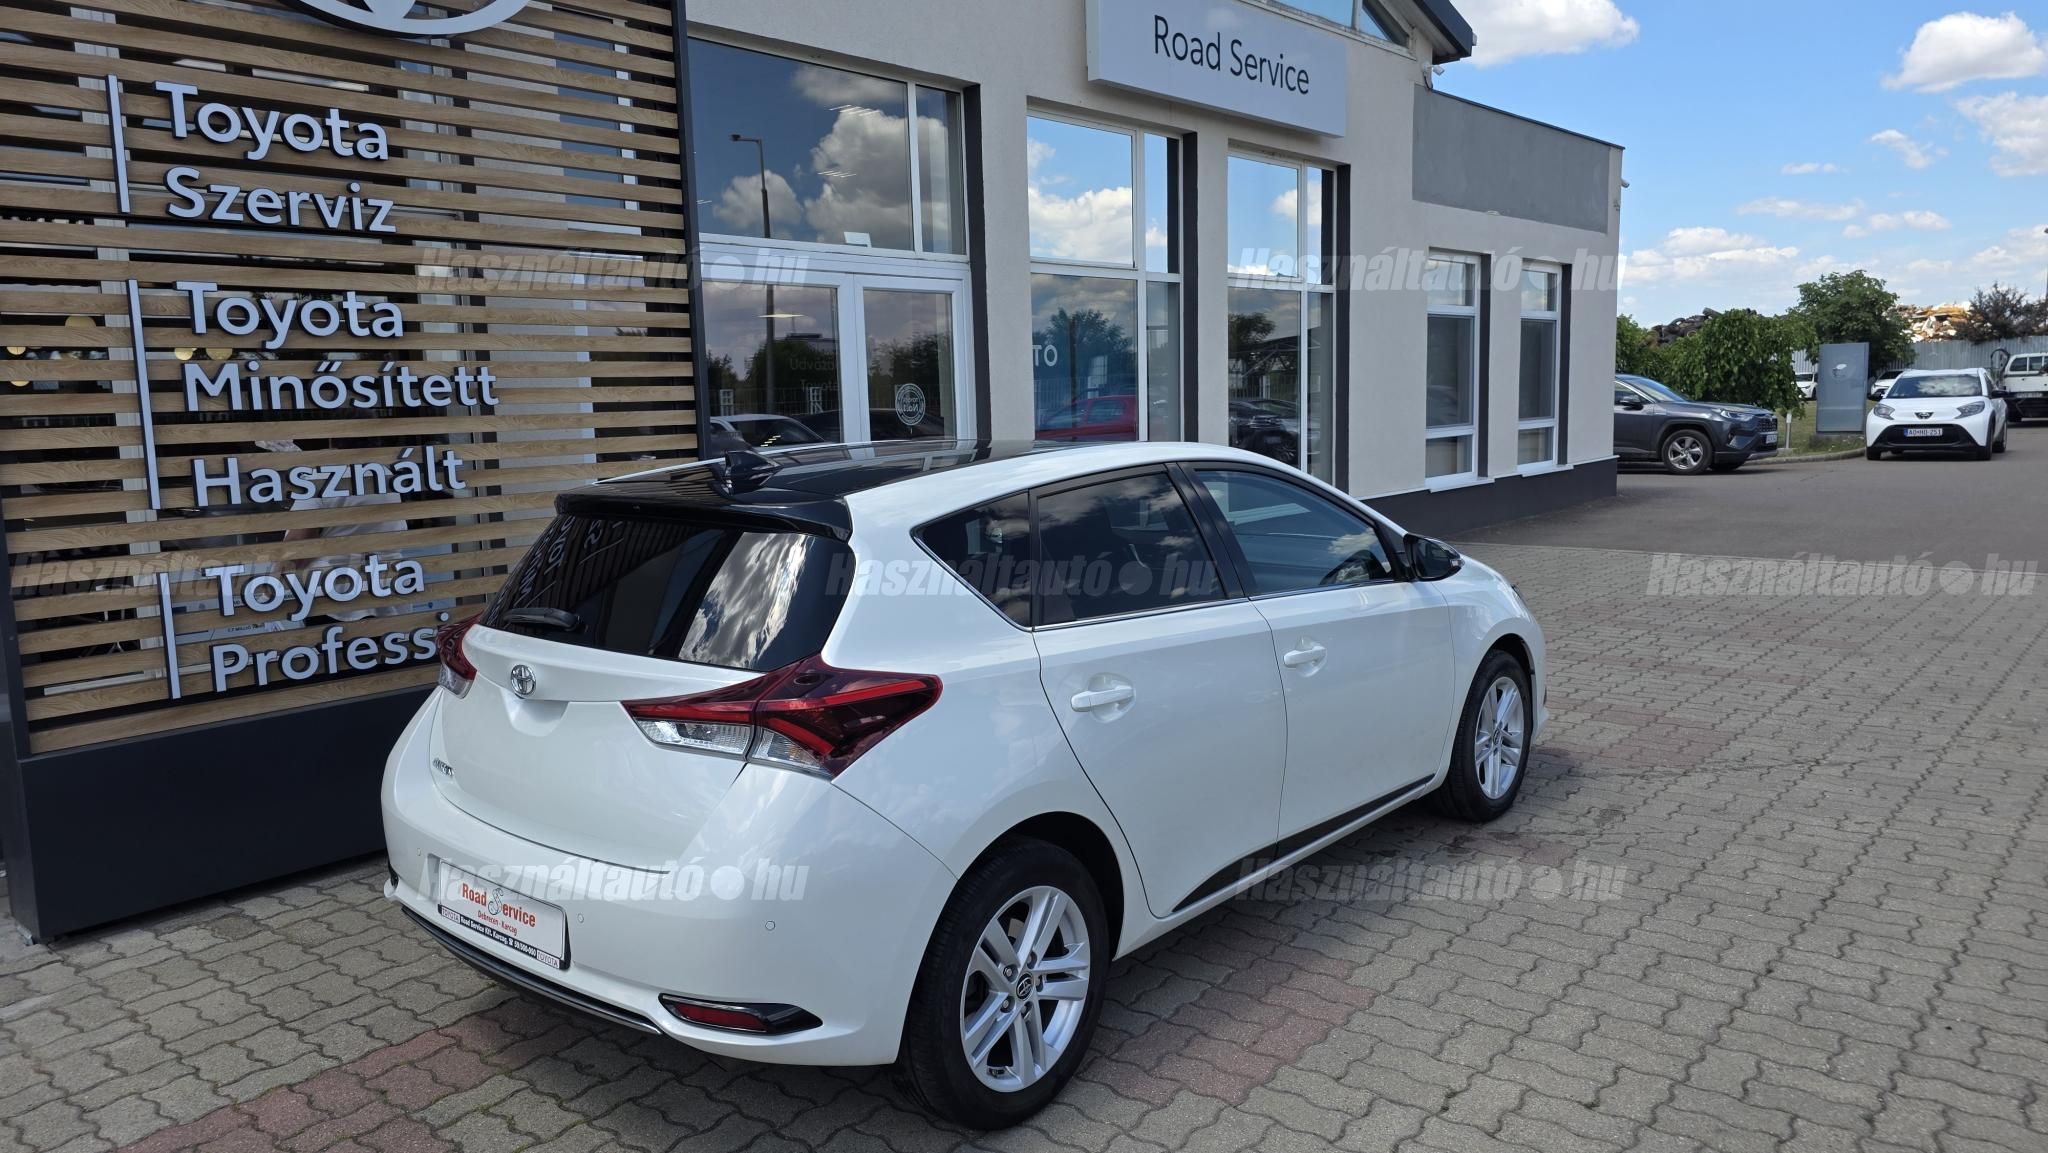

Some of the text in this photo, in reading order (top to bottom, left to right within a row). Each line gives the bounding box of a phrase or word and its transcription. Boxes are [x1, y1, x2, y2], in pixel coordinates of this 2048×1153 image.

[1154, 14, 1310, 95] Road Service
[154, 80, 389, 161] Toyota
[164, 166, 397, 233] Szerviz
[173, 280, 404, 350] Toyota
[182, 360, 499, 412] Minősített
[192, 445, 467, 507] Használt
[202, 553, 425, 622] Toyota
[211, 611, 449, 692] Profess
[462, 882, 536, 928] Road Service
